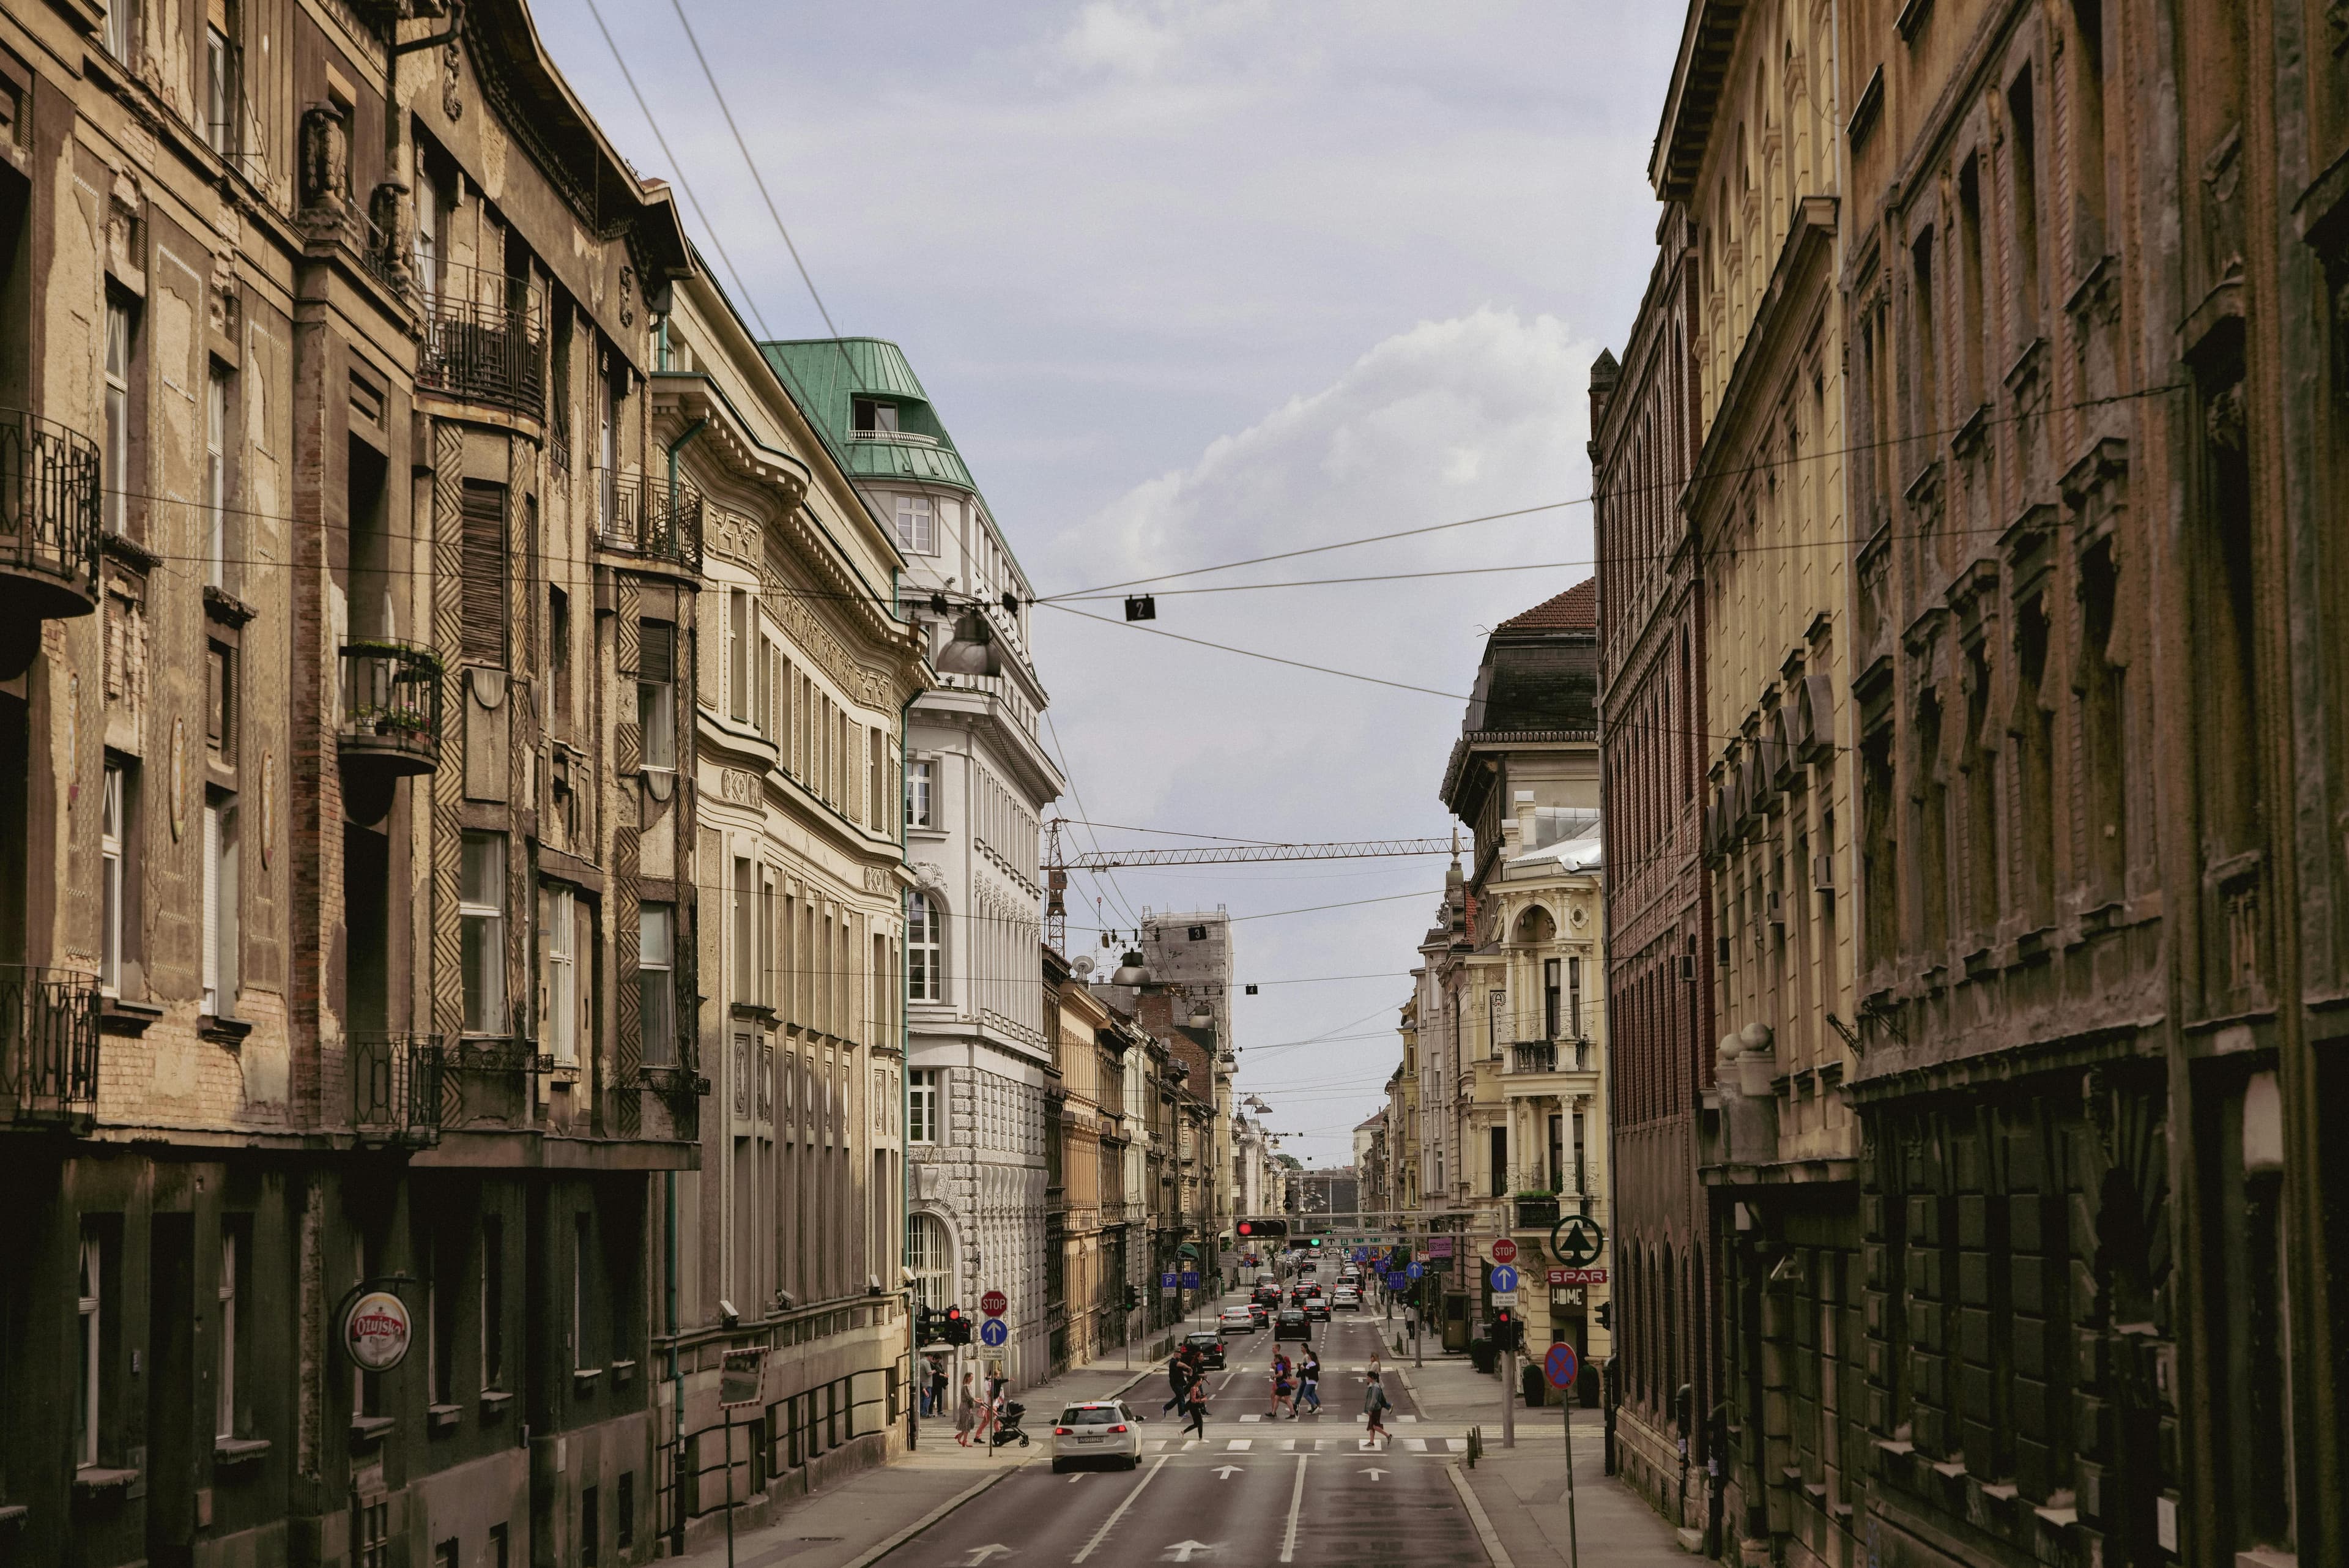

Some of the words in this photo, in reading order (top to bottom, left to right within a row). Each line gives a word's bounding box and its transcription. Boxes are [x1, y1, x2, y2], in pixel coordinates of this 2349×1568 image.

[1136, 601, 1145, 617] 2
[1195, 929, 1200, 938] 3
[1495, 1247, 1514, 1256] STOP
[1166, 1277, 1172, 1286] P
[1551, 1272, 1603, 1282] SPAR
[1552, 1288, 1583, 1305] HOME
[982, 1299, 1006, 1309] STOP
